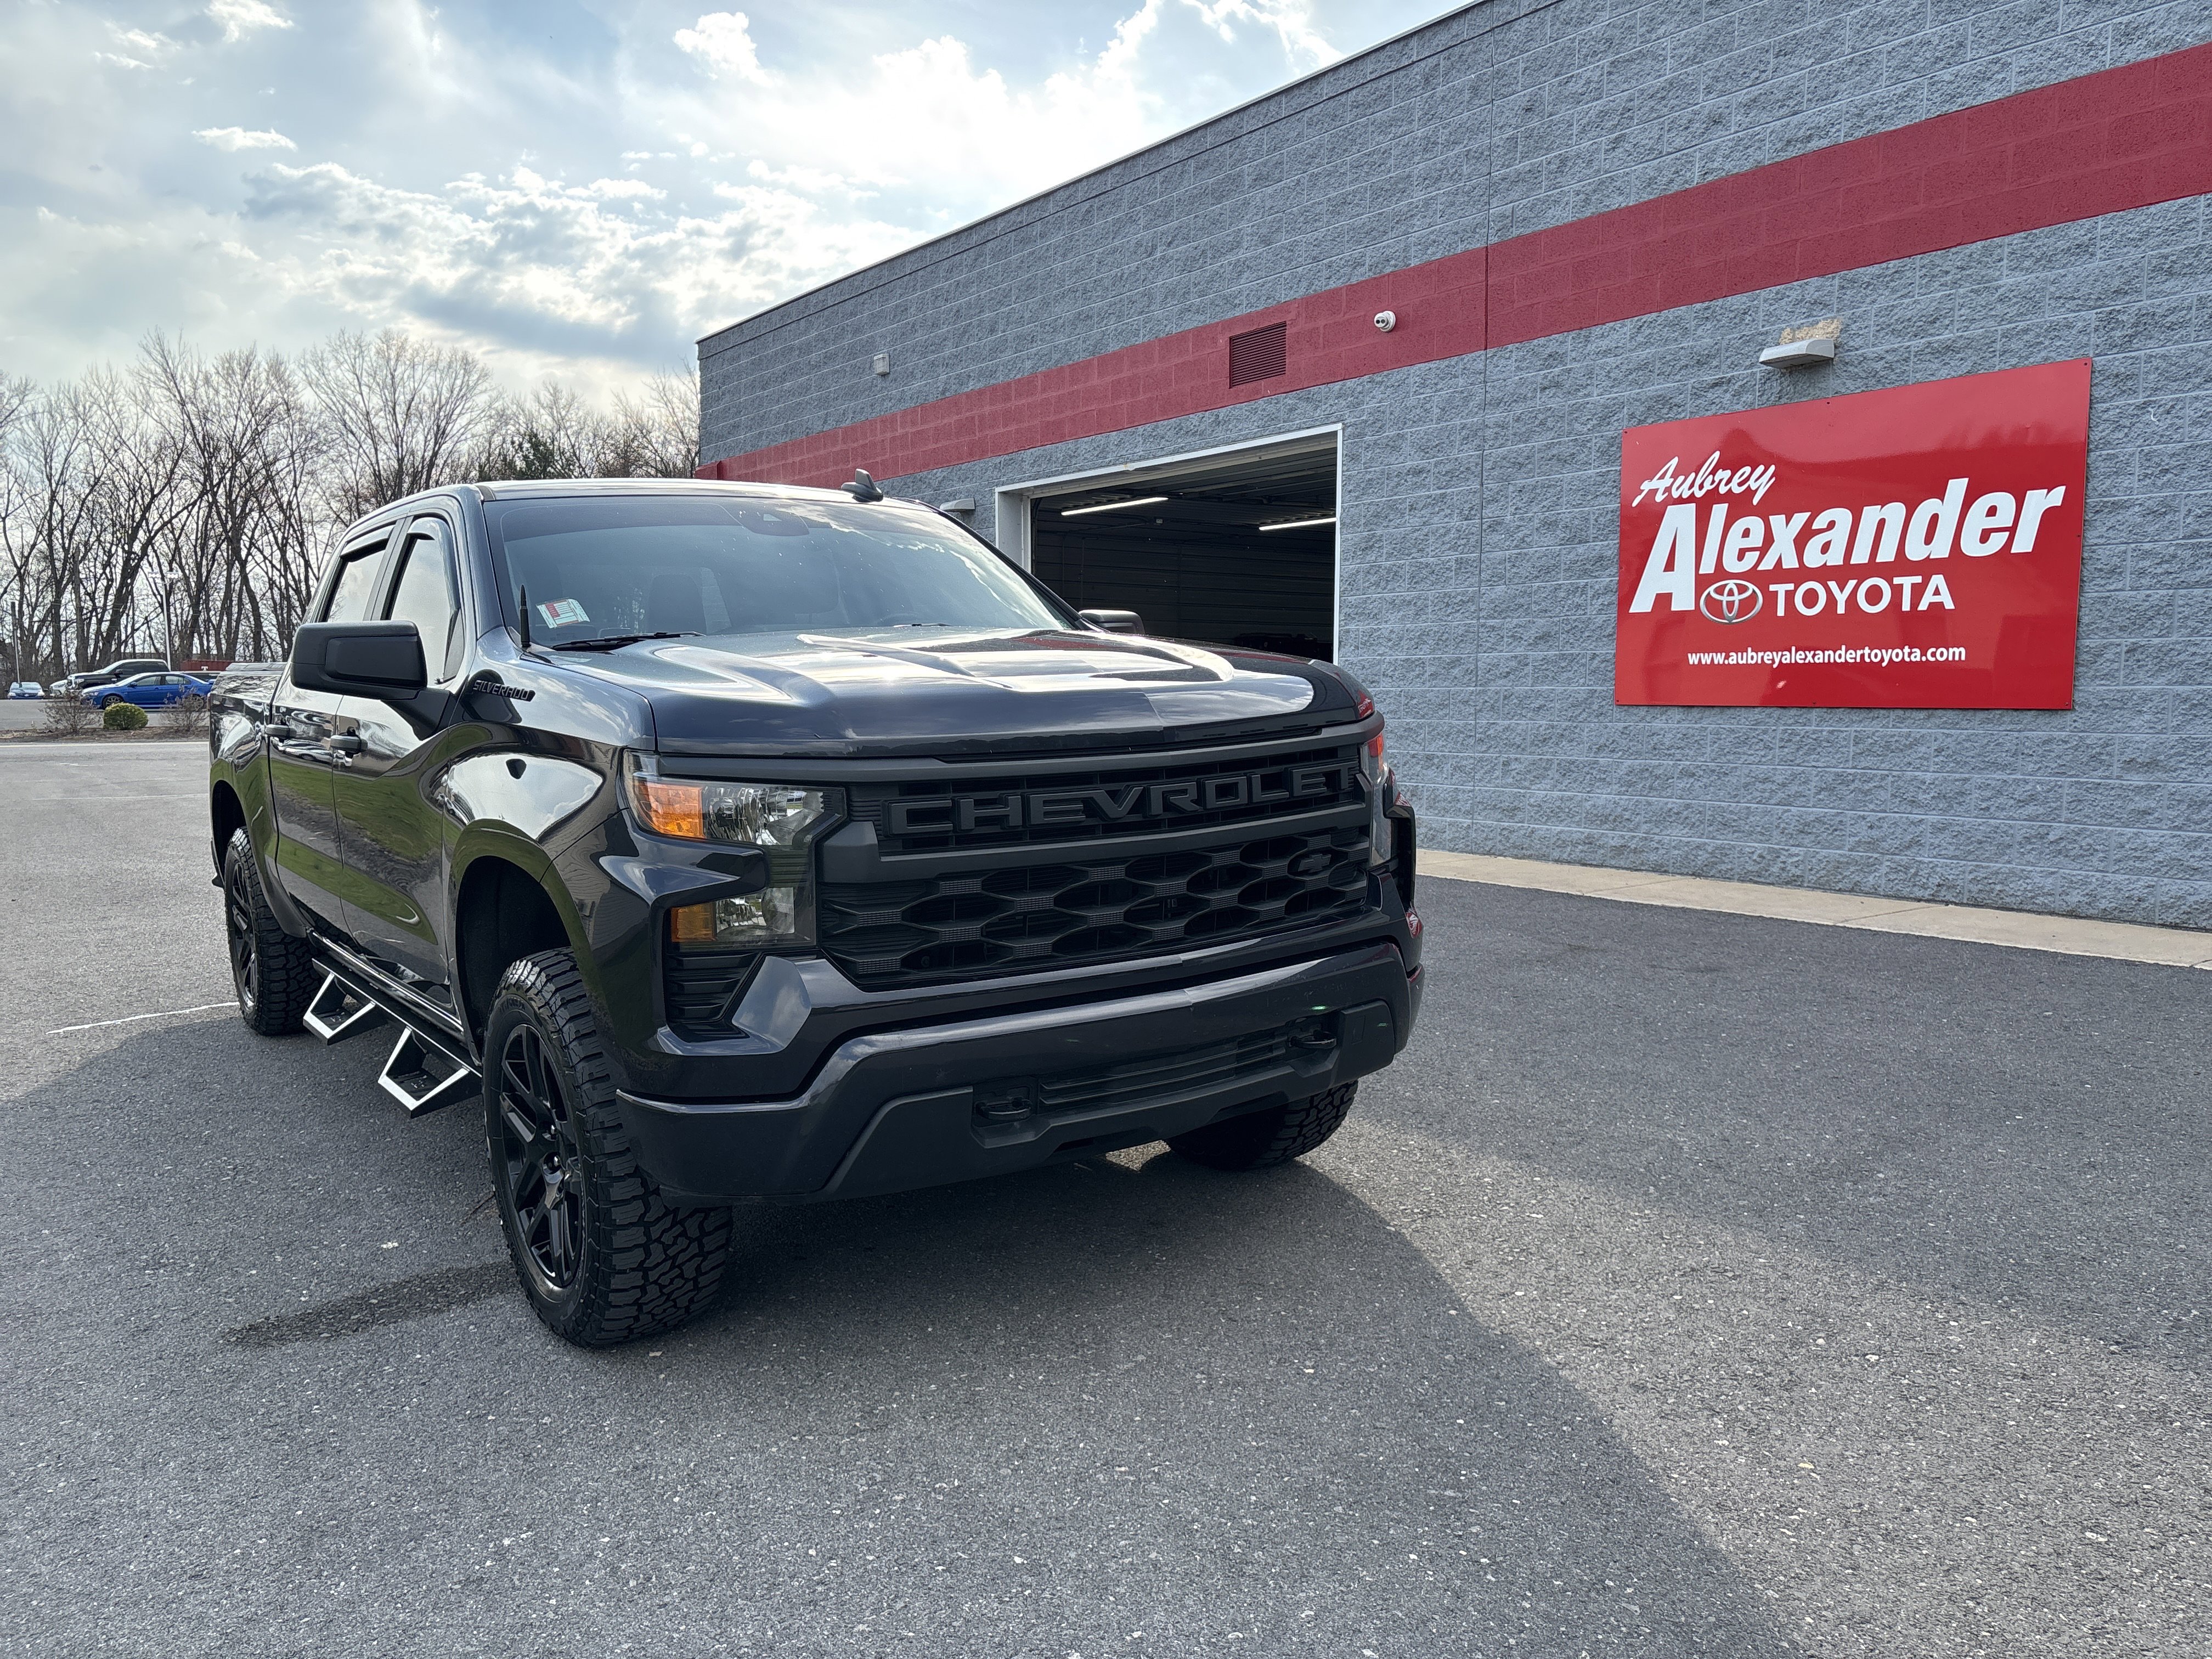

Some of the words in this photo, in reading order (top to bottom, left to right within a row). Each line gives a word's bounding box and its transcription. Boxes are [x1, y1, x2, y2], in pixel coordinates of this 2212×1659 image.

[1632, 450, 1775, 506] Aubrey
[1629, 477, 2067, 613] Alexander
[1769, 574, 1955, 617] TOYOTA
[1688, 645, 1966, 668] www.aubreyalexandertoyota.com
[472, 680, 529, 700] SILVERADO
[887, 761, 1359, 834] CHEVROLET
